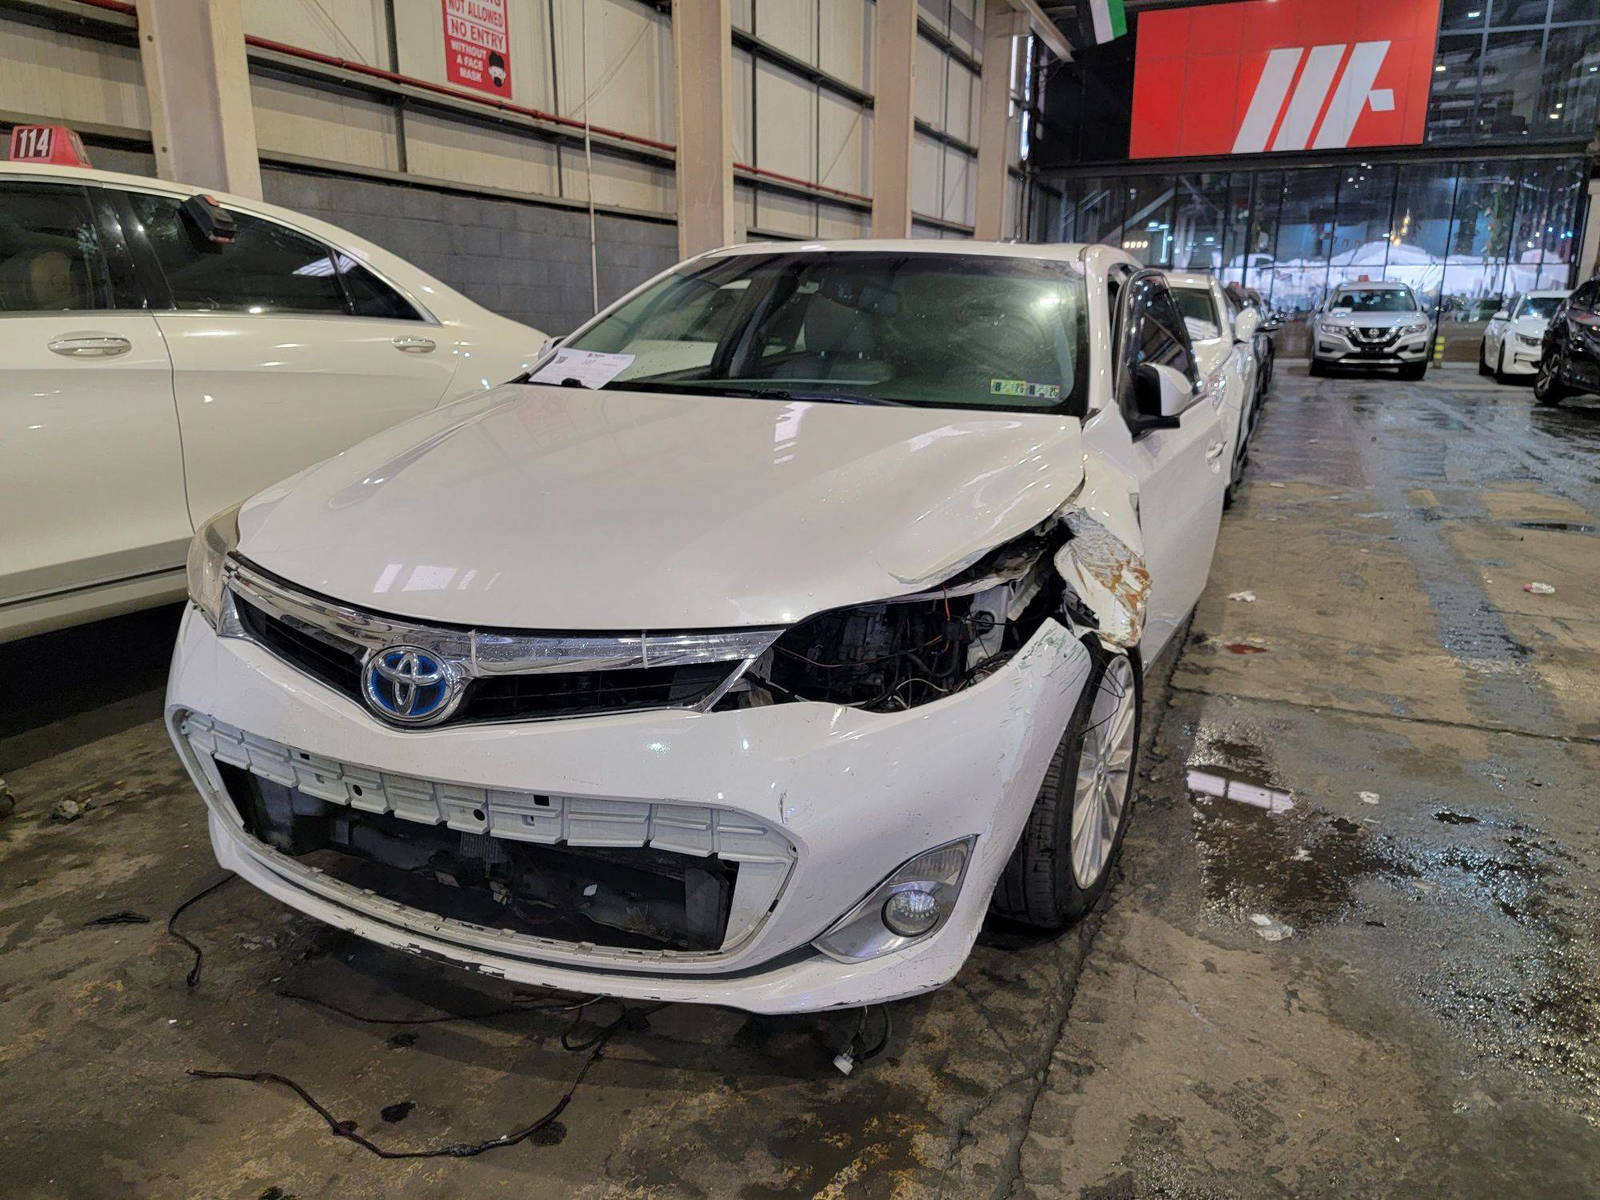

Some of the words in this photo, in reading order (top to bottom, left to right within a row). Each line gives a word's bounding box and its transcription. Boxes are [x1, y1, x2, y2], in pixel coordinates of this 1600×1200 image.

[449, 0, 464, 14] NOT
[468, 2, 503, 27] ALLOWED
[451, 19, 467, 37] NO
[470, 25, 503, 50] ENTRY
[450, 39, 487, 59] WITHOUT
[456, 54, 463, 64] A
[459, 67, 482, 83] MASK
[18, 127, 50, 158] 114
